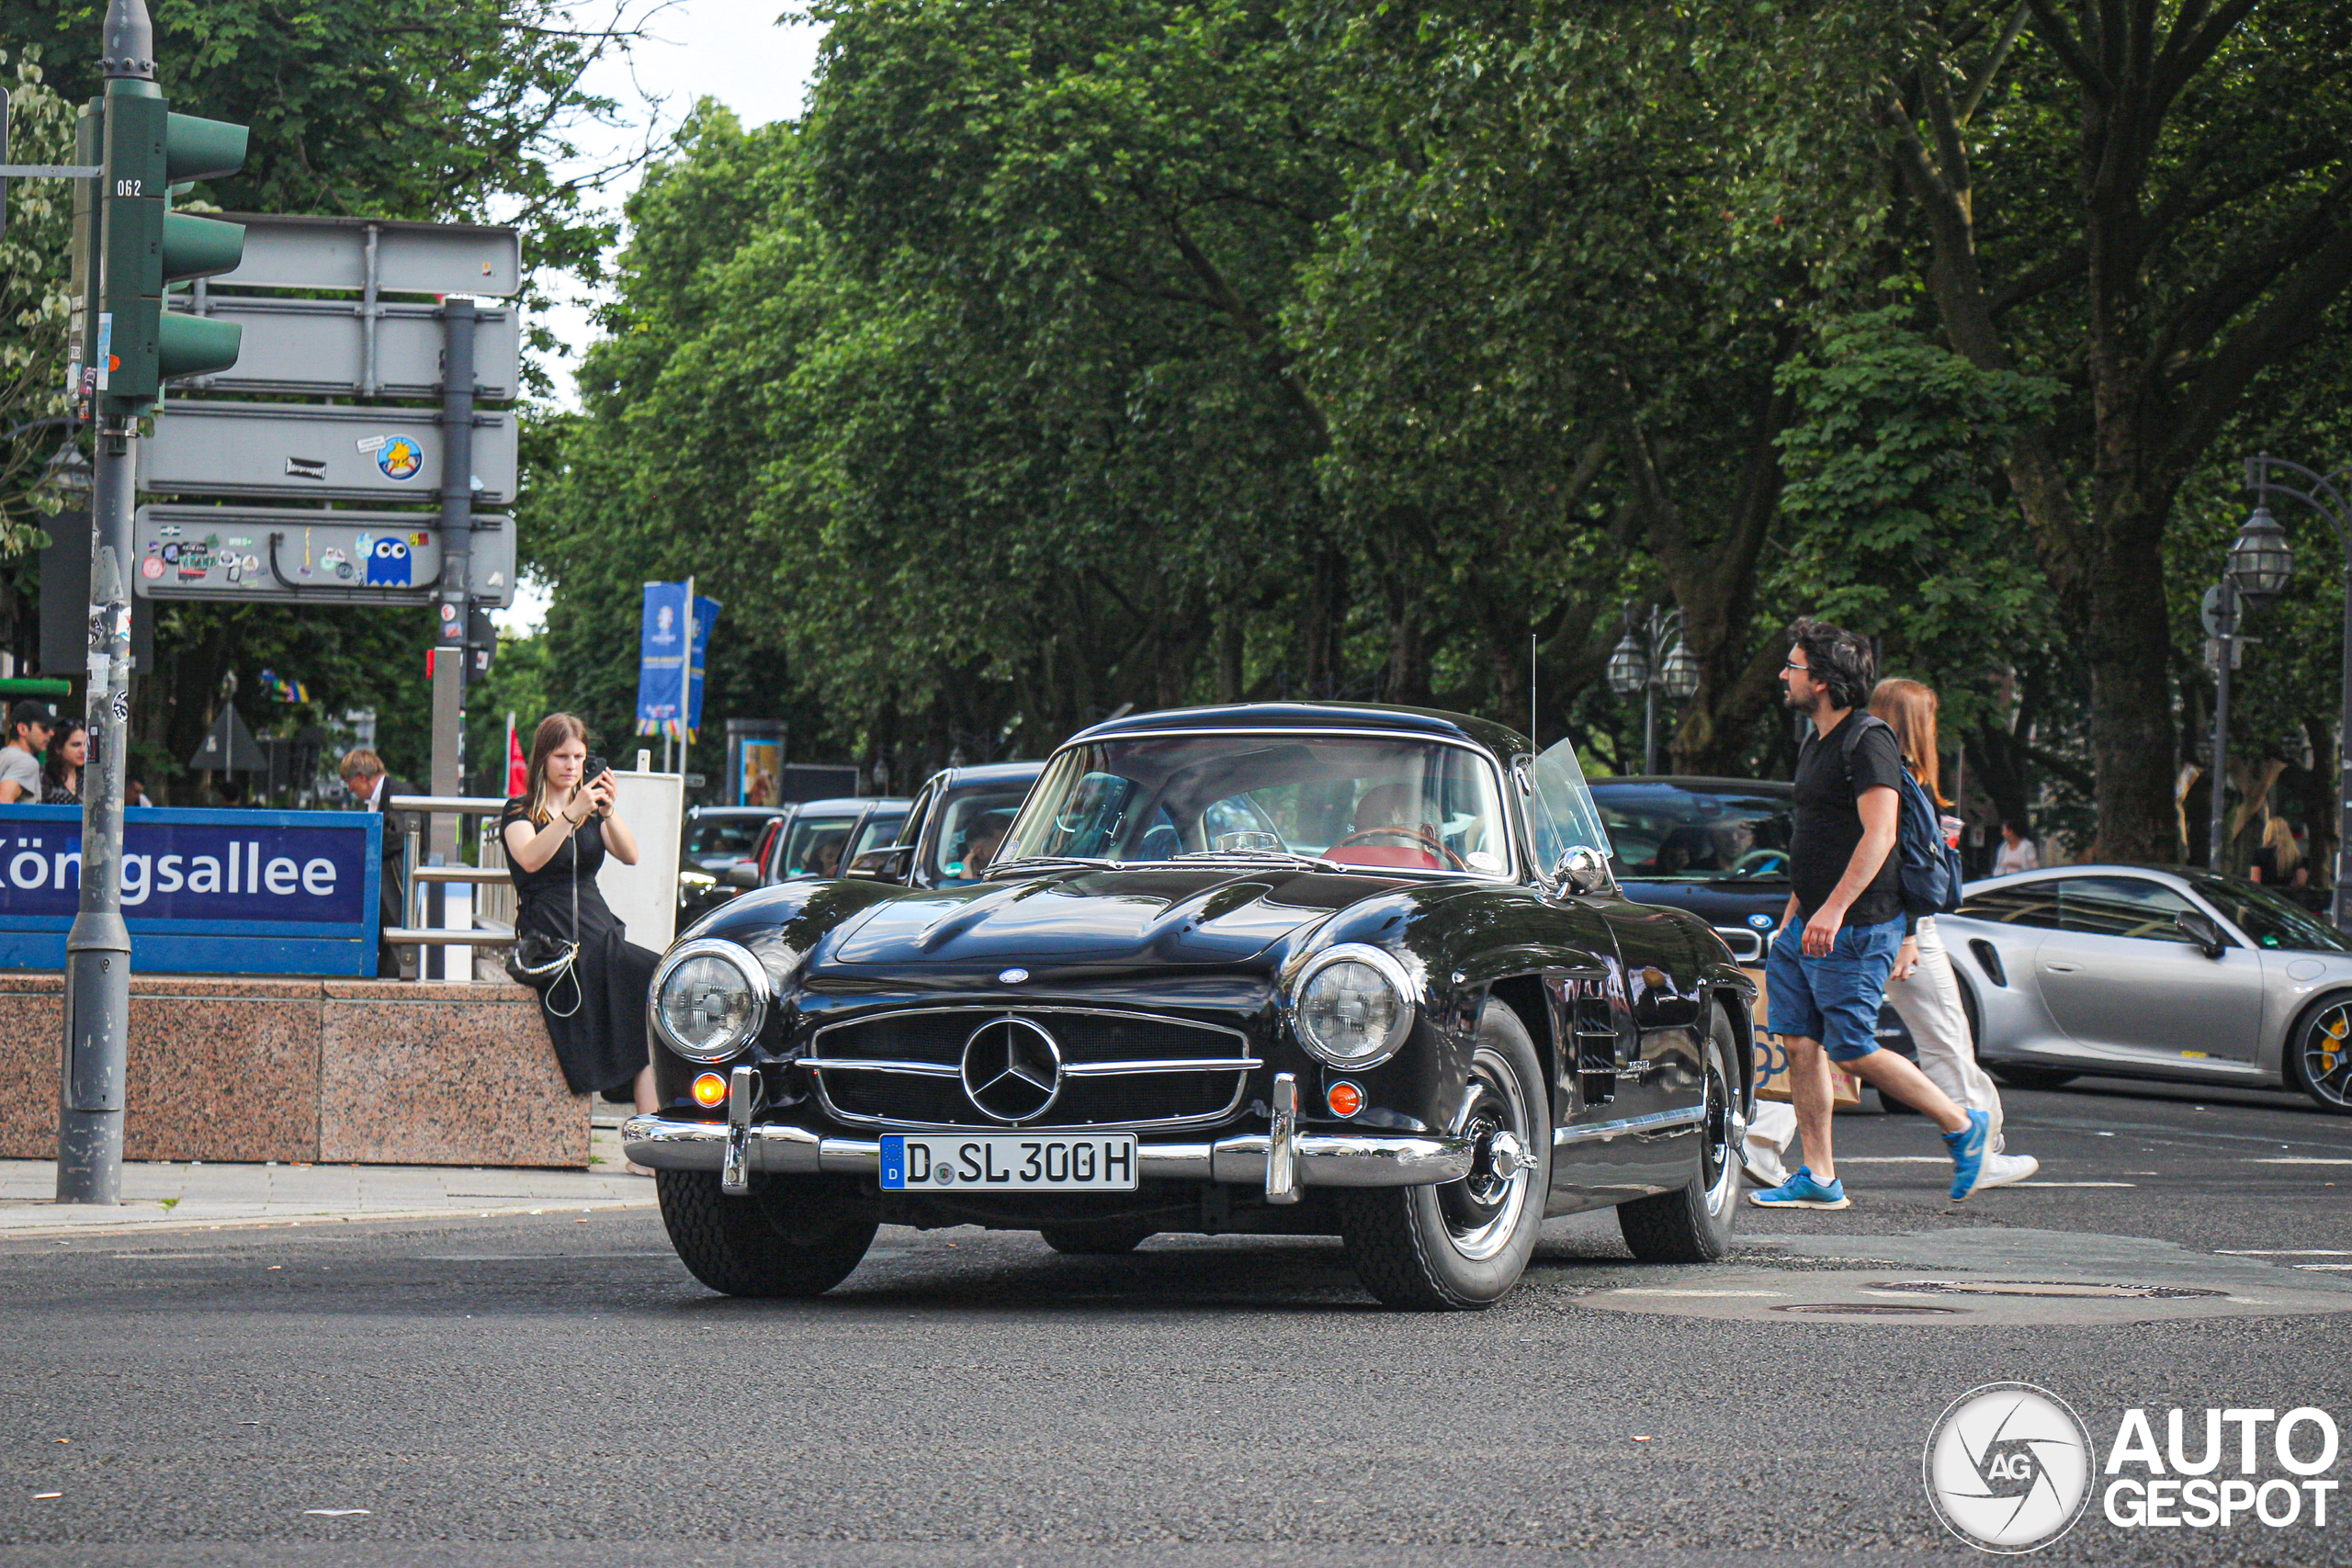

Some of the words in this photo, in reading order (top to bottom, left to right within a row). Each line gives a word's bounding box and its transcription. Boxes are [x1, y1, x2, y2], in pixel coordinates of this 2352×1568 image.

[118, 179, 141, 197] 062
[0, 838, 337, 906] öngsallee
[888, 1168, 899, 1180] D
[907, 1143, 932, 1182] D
[958, 1142, 1011, 1182] SL
